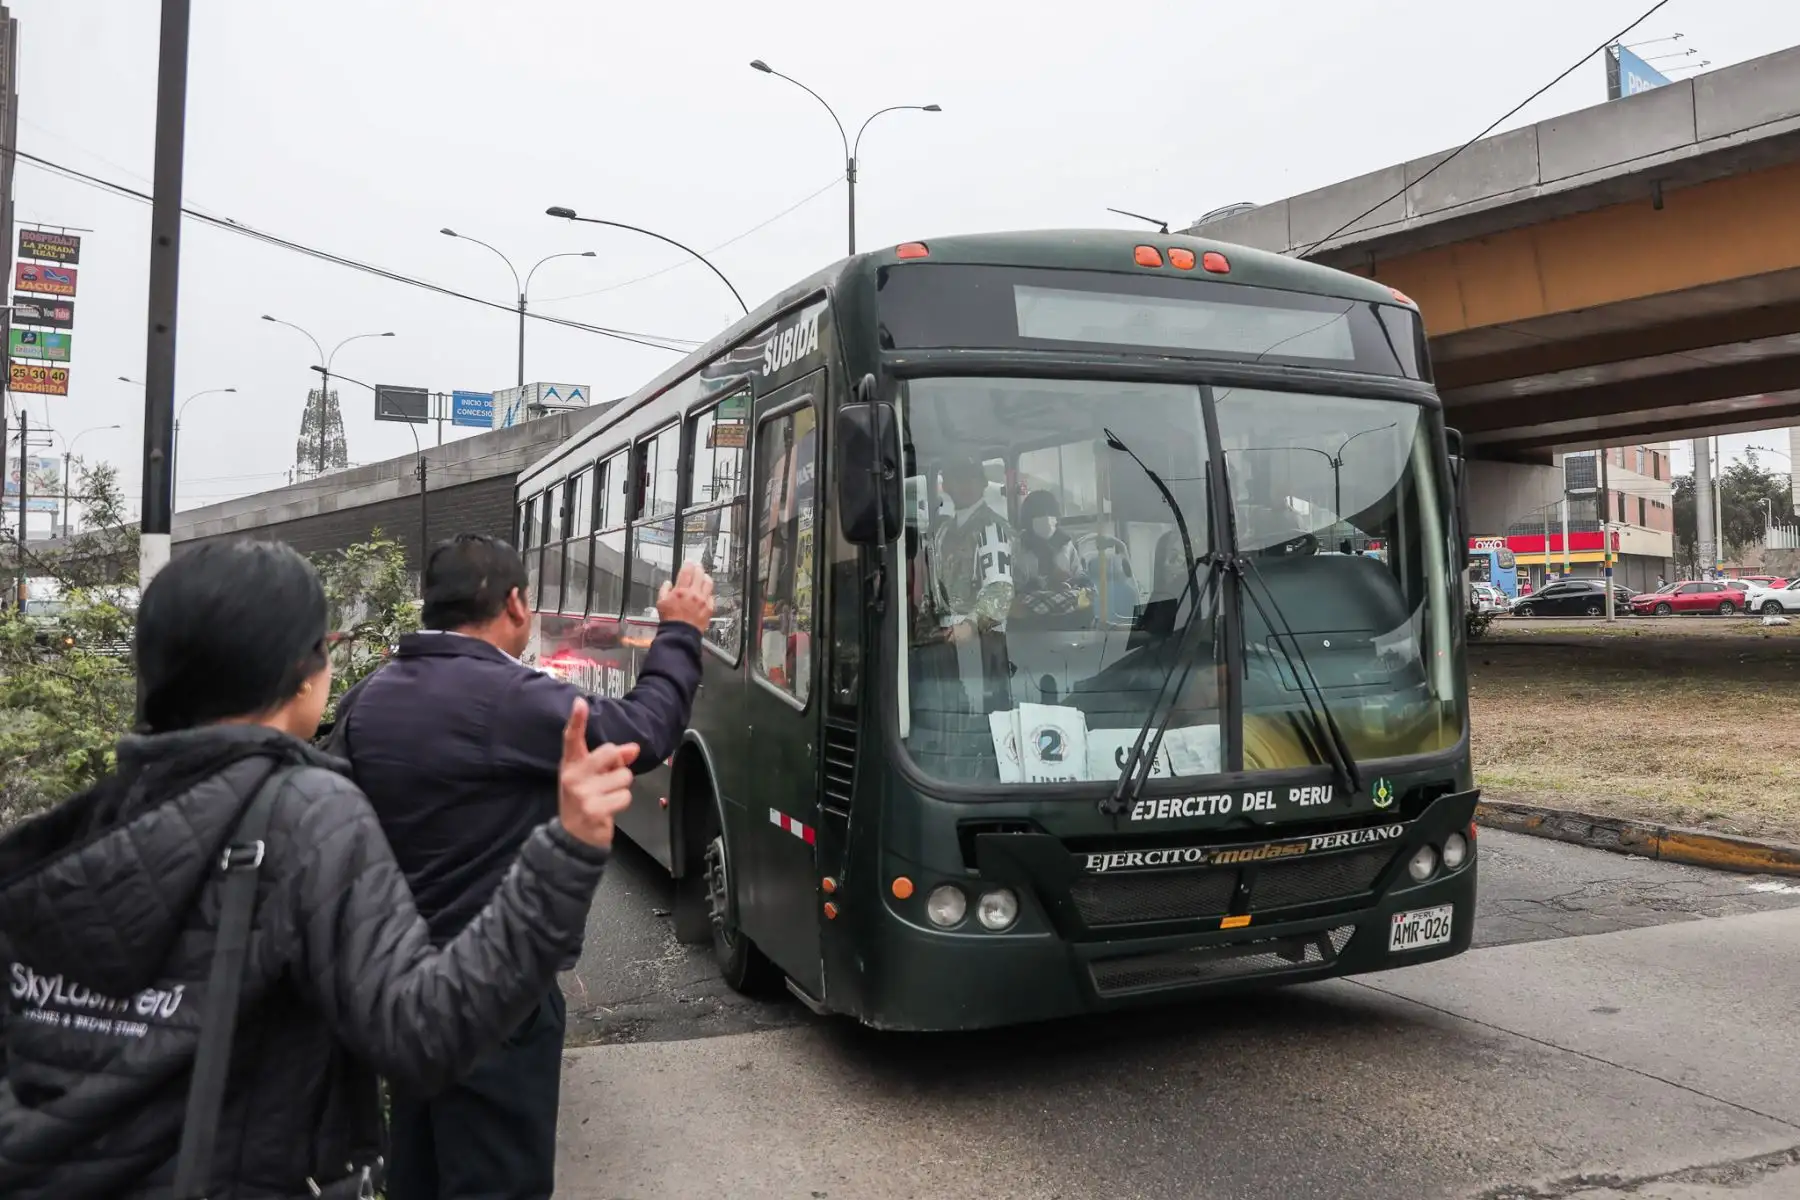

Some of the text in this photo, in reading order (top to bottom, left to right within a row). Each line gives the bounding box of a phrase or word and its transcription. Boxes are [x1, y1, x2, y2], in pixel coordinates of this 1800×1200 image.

[23, 241, 75, 254] LA POSADA
[32, 249, 57, 258] REAL
[17, 281, 73, 293] JACUZZI
[43, 307, 70, 321] YouTube
[763, 313, 819, 377] SUBIDA
[13, 368, 65, 381] 25 30 40
[10, 381, 66, 394] COCHERA
[461, 399, 482, 407] INICIO
[1475, 539, 1503, 550] OXXO
[607, 667, 625, 699] PERU
[1040, 729, 1063, 762] 2
[1131, 785, 1333, 821] EJERCITO DEL PERU
[1086, 824, 1404, 872] EJERCITO modasa PERUANO
[1412, 911, 1434, 920] PERU
[1393, 915, 1449, 946] AMR-026
